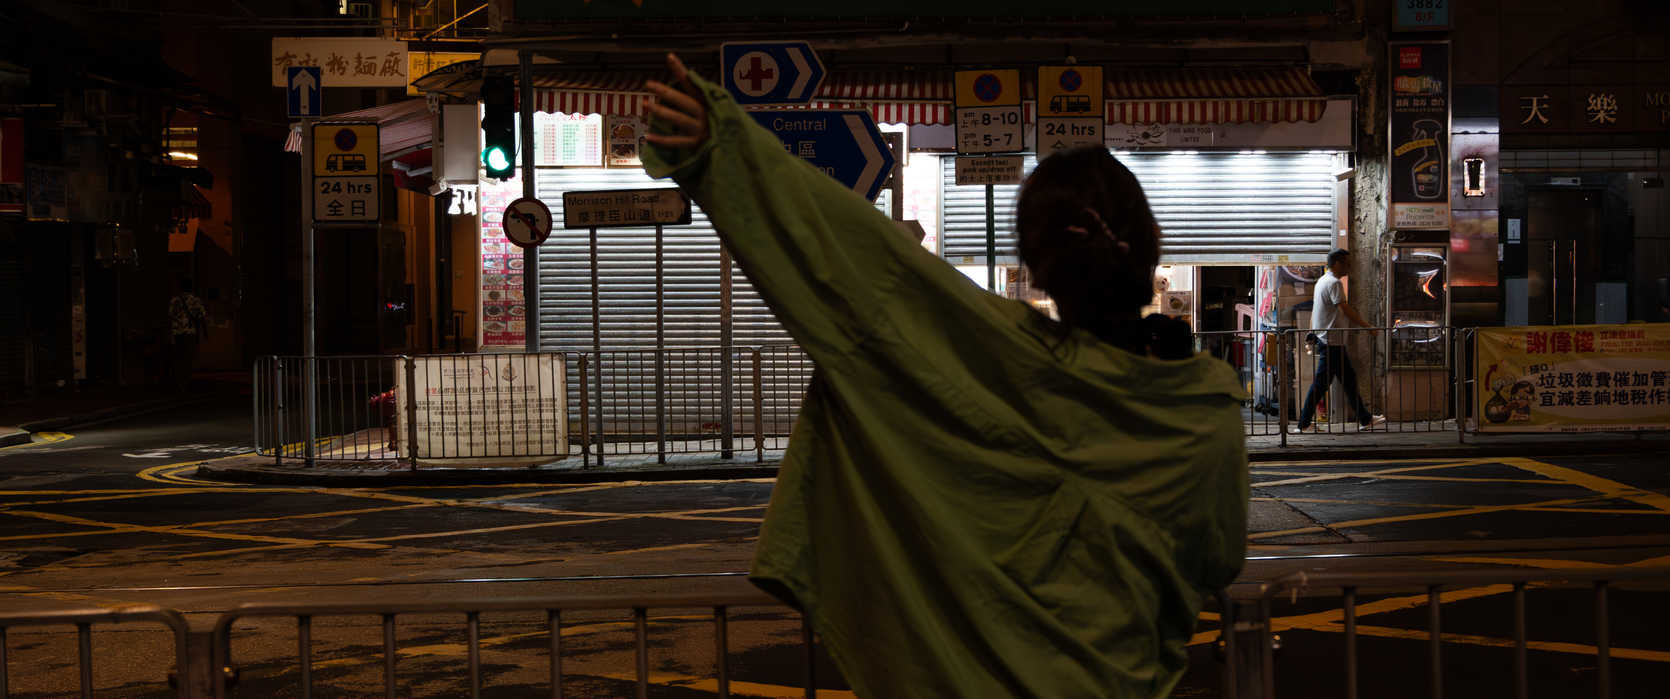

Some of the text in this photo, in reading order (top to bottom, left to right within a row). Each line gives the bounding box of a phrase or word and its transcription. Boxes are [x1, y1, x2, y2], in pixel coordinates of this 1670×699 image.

[773, 118, 827, 131] Central
[982, 112, 1018, 126] 8-10
[1045, 123, 1097, 137] 24 hrs
[321, 181, 372, 194] 24 hrs
[568, 195, 612, 207] Morrison
[631, 192, 660, 204] Road
[327, 199, 367, 217] 全日
[578, 208, 653, 224] 摩理臣山道
[1527, 330, 1595, 354] 謝偉俊
[1539, 389, 1670, 407] 宜減差餉地稅作
